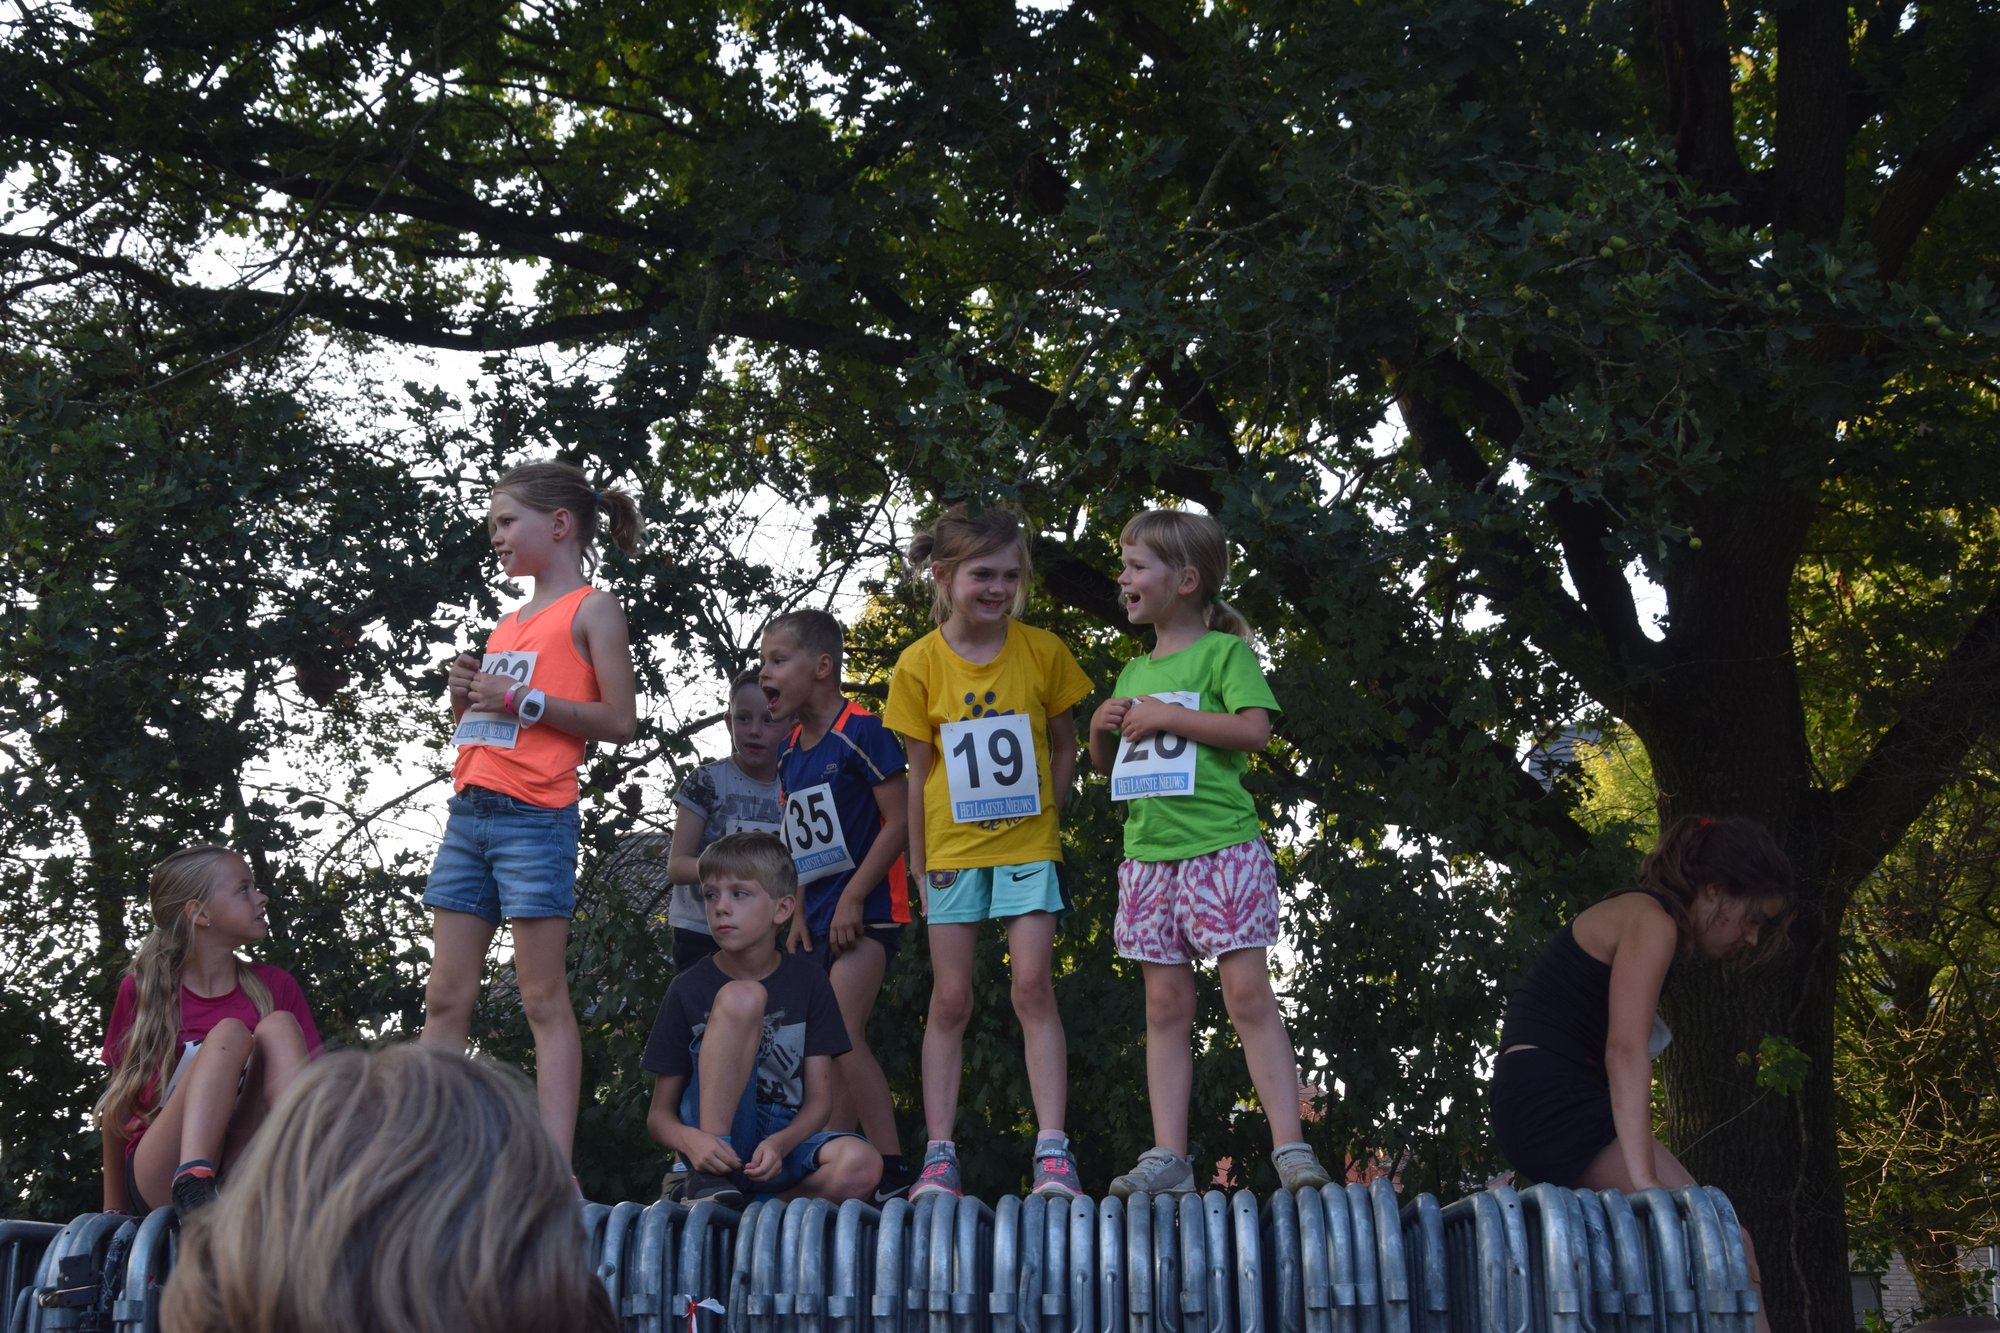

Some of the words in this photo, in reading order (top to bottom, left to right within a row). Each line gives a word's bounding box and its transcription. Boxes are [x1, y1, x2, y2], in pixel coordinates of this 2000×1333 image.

[953, 728, 1023, 789] 19
[1118, 779, 1131, 794] HET
[1131, 777, 1158, 792] LAATSTE
[1158, 775, 1185, 790] NIEUWS
[960, 803, 974, 818] HET
[975, 801, 1004, 816] LAATSTE
[1005, 798, 1033, 813] NIEUWS
